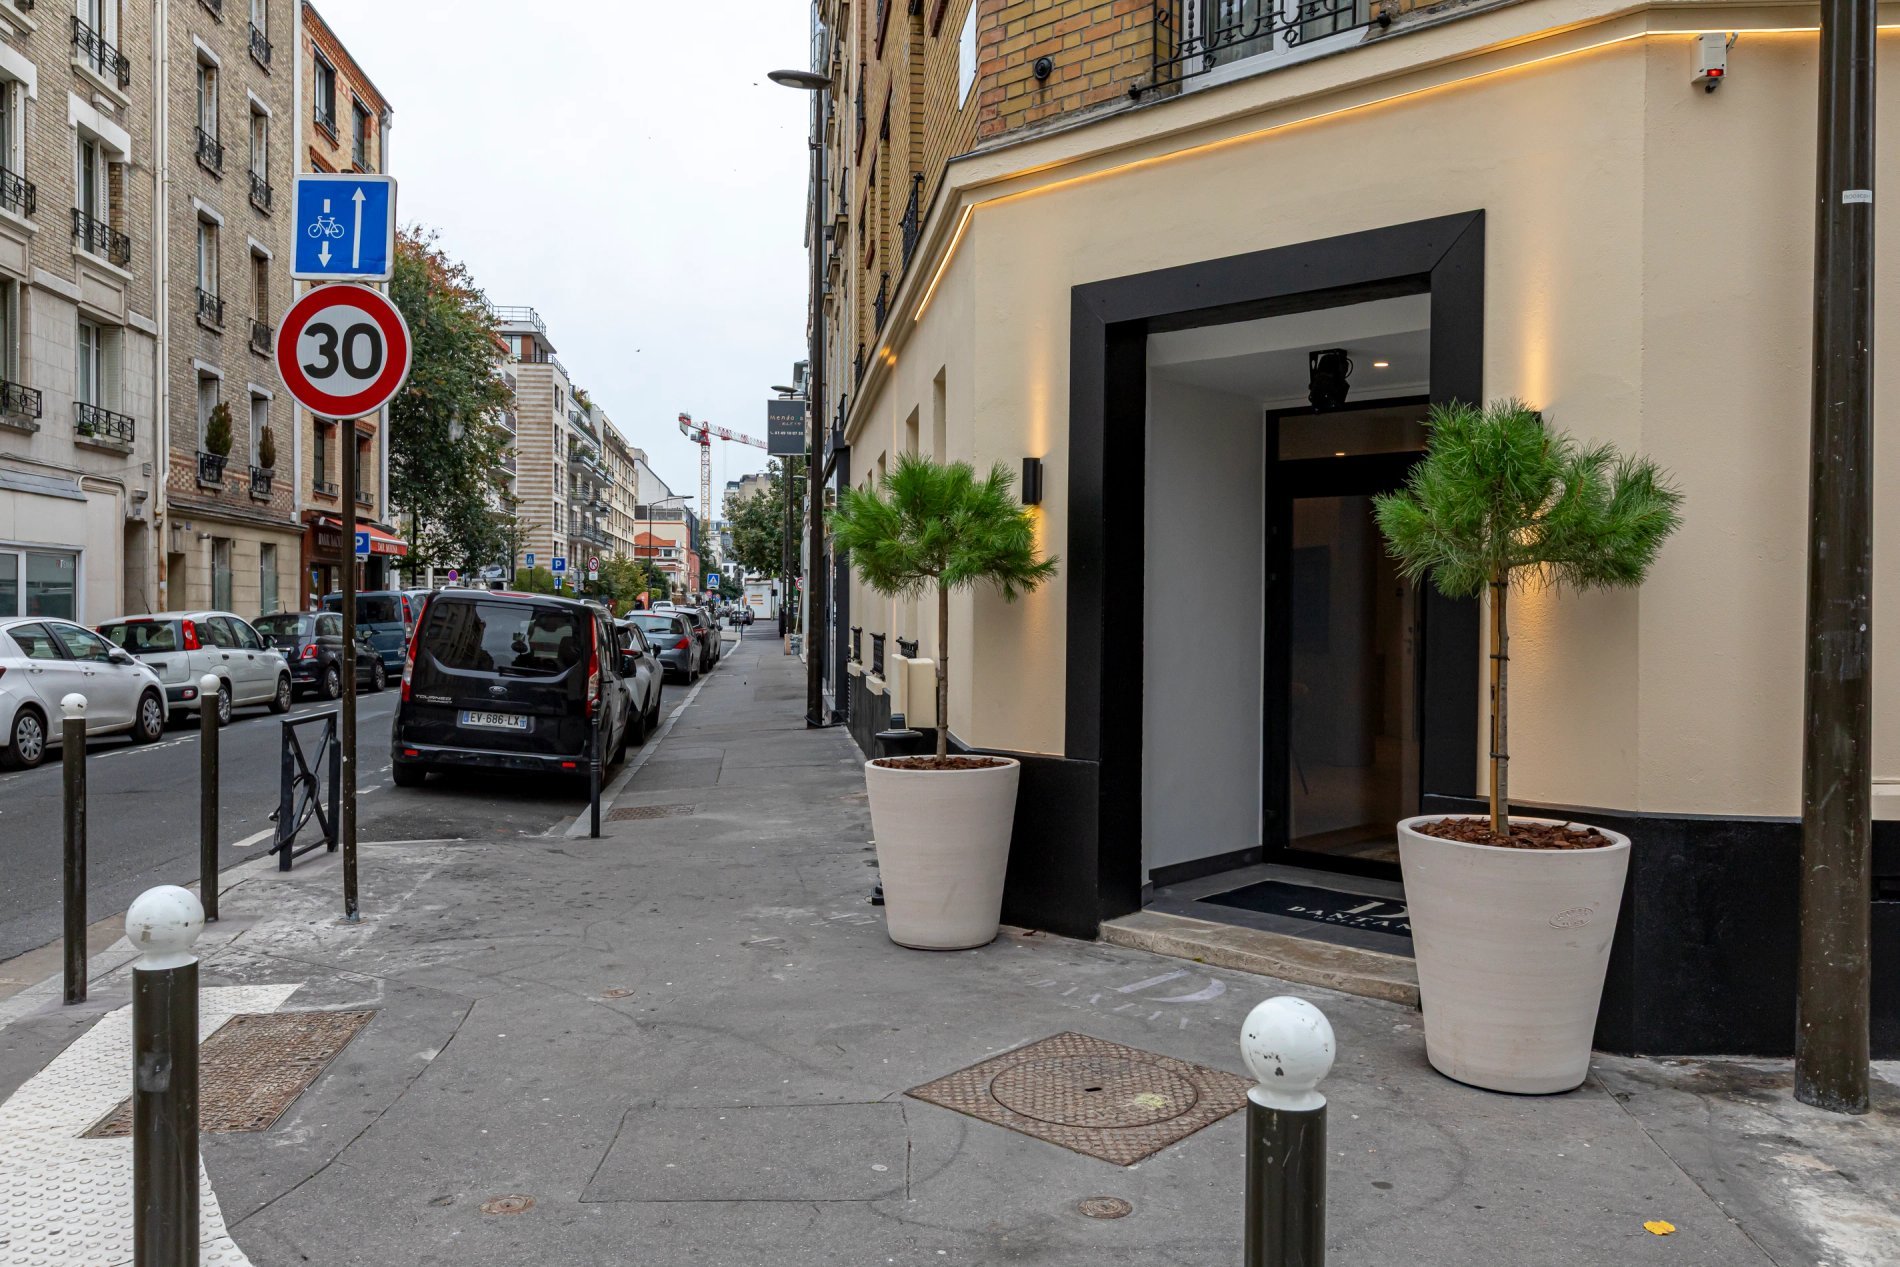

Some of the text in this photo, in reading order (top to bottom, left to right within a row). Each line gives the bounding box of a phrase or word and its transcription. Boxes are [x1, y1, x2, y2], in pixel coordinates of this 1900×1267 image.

[303, 322, 383, 380] 30
[555, 560, 562, 569] P
[470, 712, 520, 727] EV-686-LX
